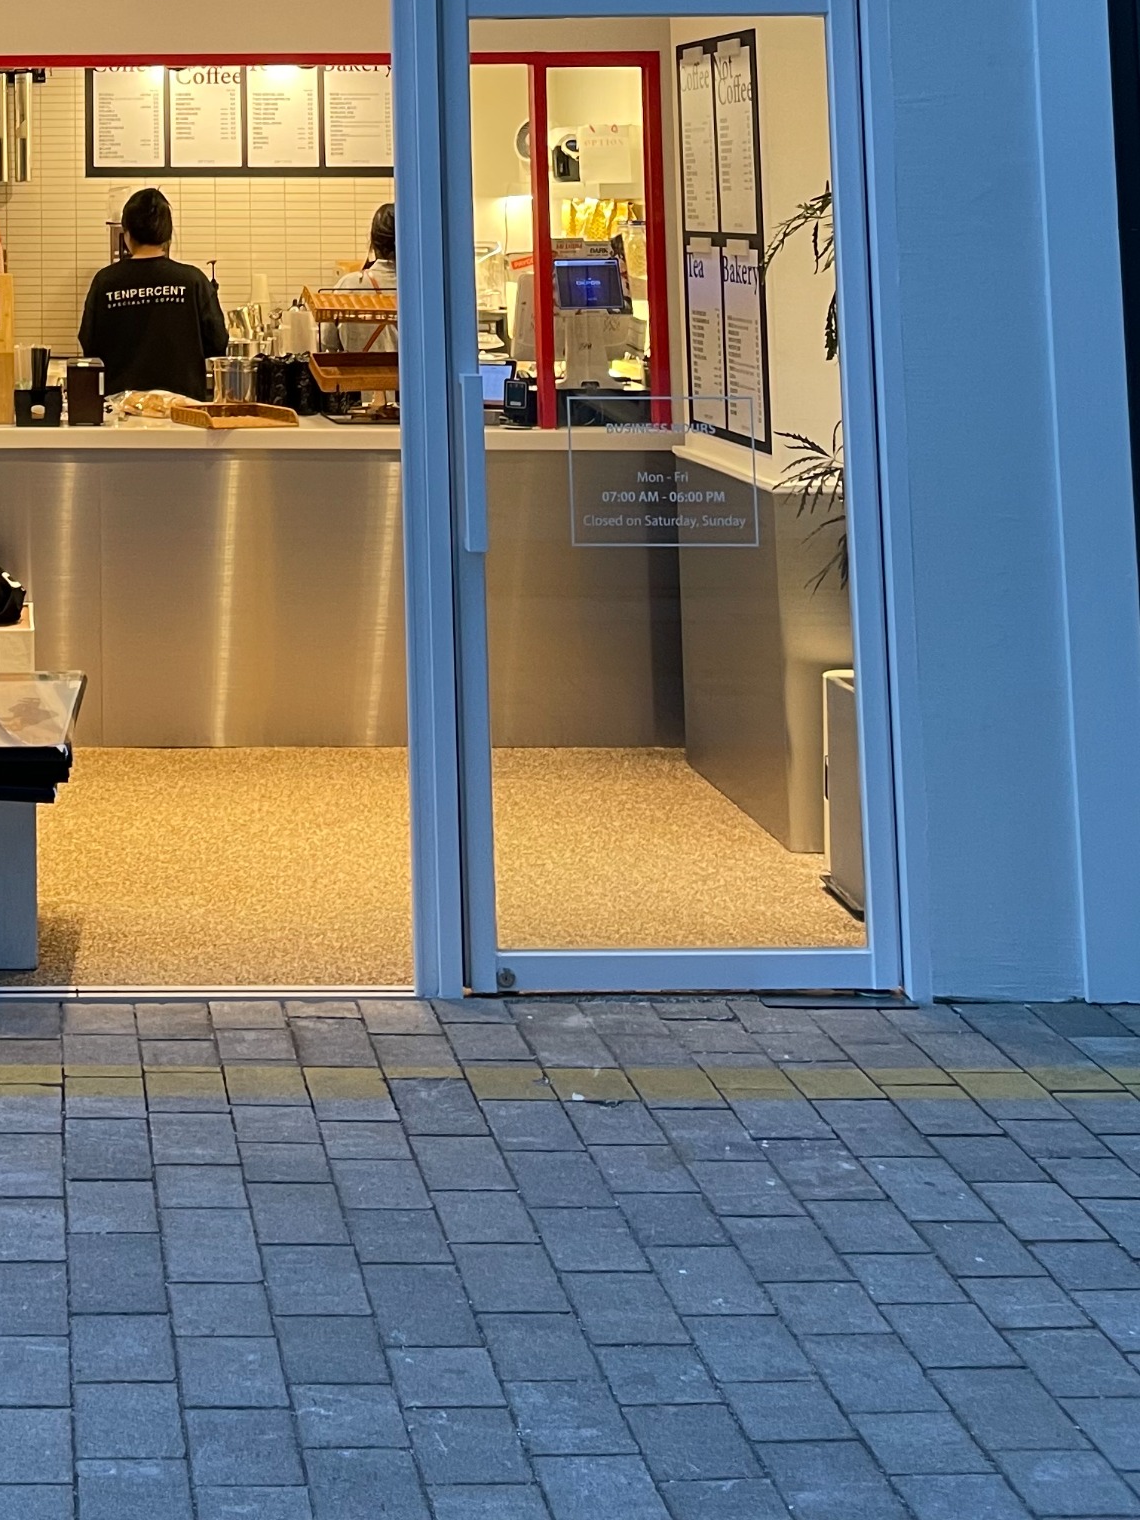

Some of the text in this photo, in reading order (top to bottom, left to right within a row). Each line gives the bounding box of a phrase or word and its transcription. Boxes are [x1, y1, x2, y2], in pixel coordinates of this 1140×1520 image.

[175, 66, 241, 85] Coffee
[717, 73, 753, 105] Coffee
[686, 252, 704, 278] Tea
[722, 255, 759, 295] Bakery
[106, 285, 186, 301] TENPERCENT
[606, 423, 668, 434] BUSINESS
[637, 472, 664, 483] Mon
[674, 471, 689, 483] Fri
[602, 491, 636, 503] 07:00
[638, 492, 659, 502] AM
[669, 491, 703, 502] 06:00
[706, 491, 725, 502] PM
[583, 515, 746, 529] Closed on Saturday, Sunday
